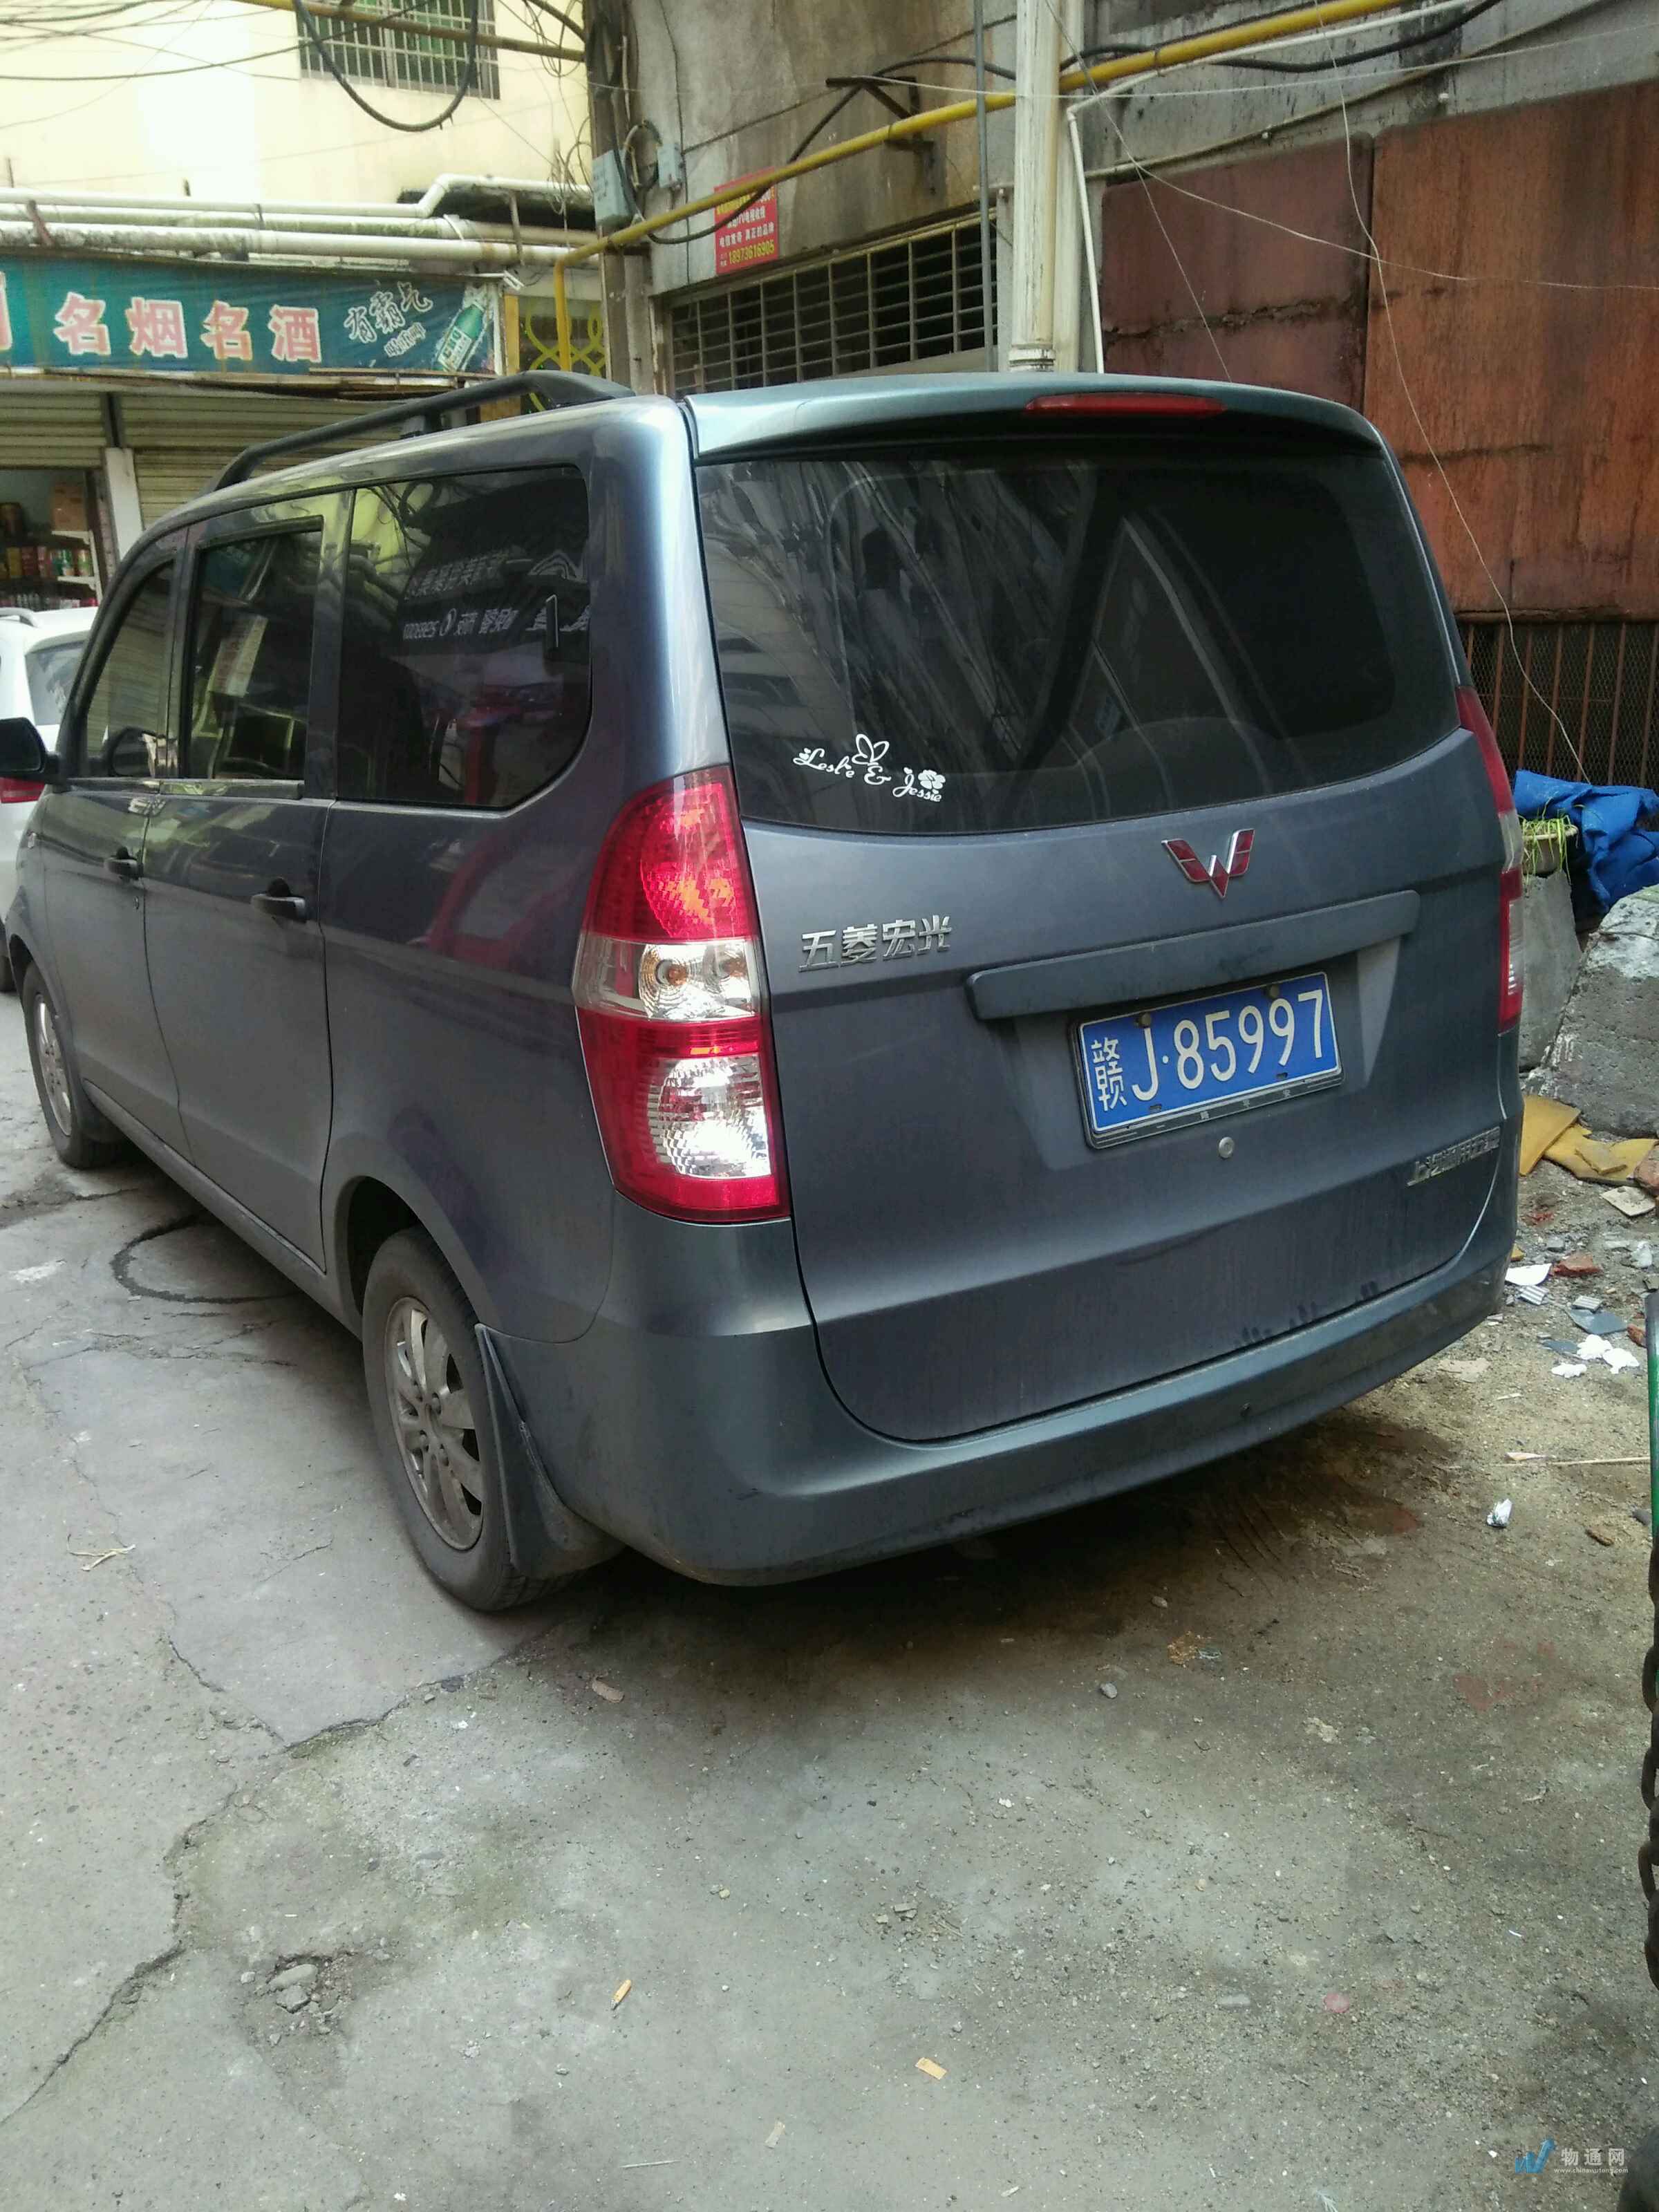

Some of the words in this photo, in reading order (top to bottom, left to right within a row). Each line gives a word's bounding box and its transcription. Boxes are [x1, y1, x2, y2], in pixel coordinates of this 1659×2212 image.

[53, 292, 322, 363] 名烟名酒
[798, 915, 953, 973] 五菱宏光
